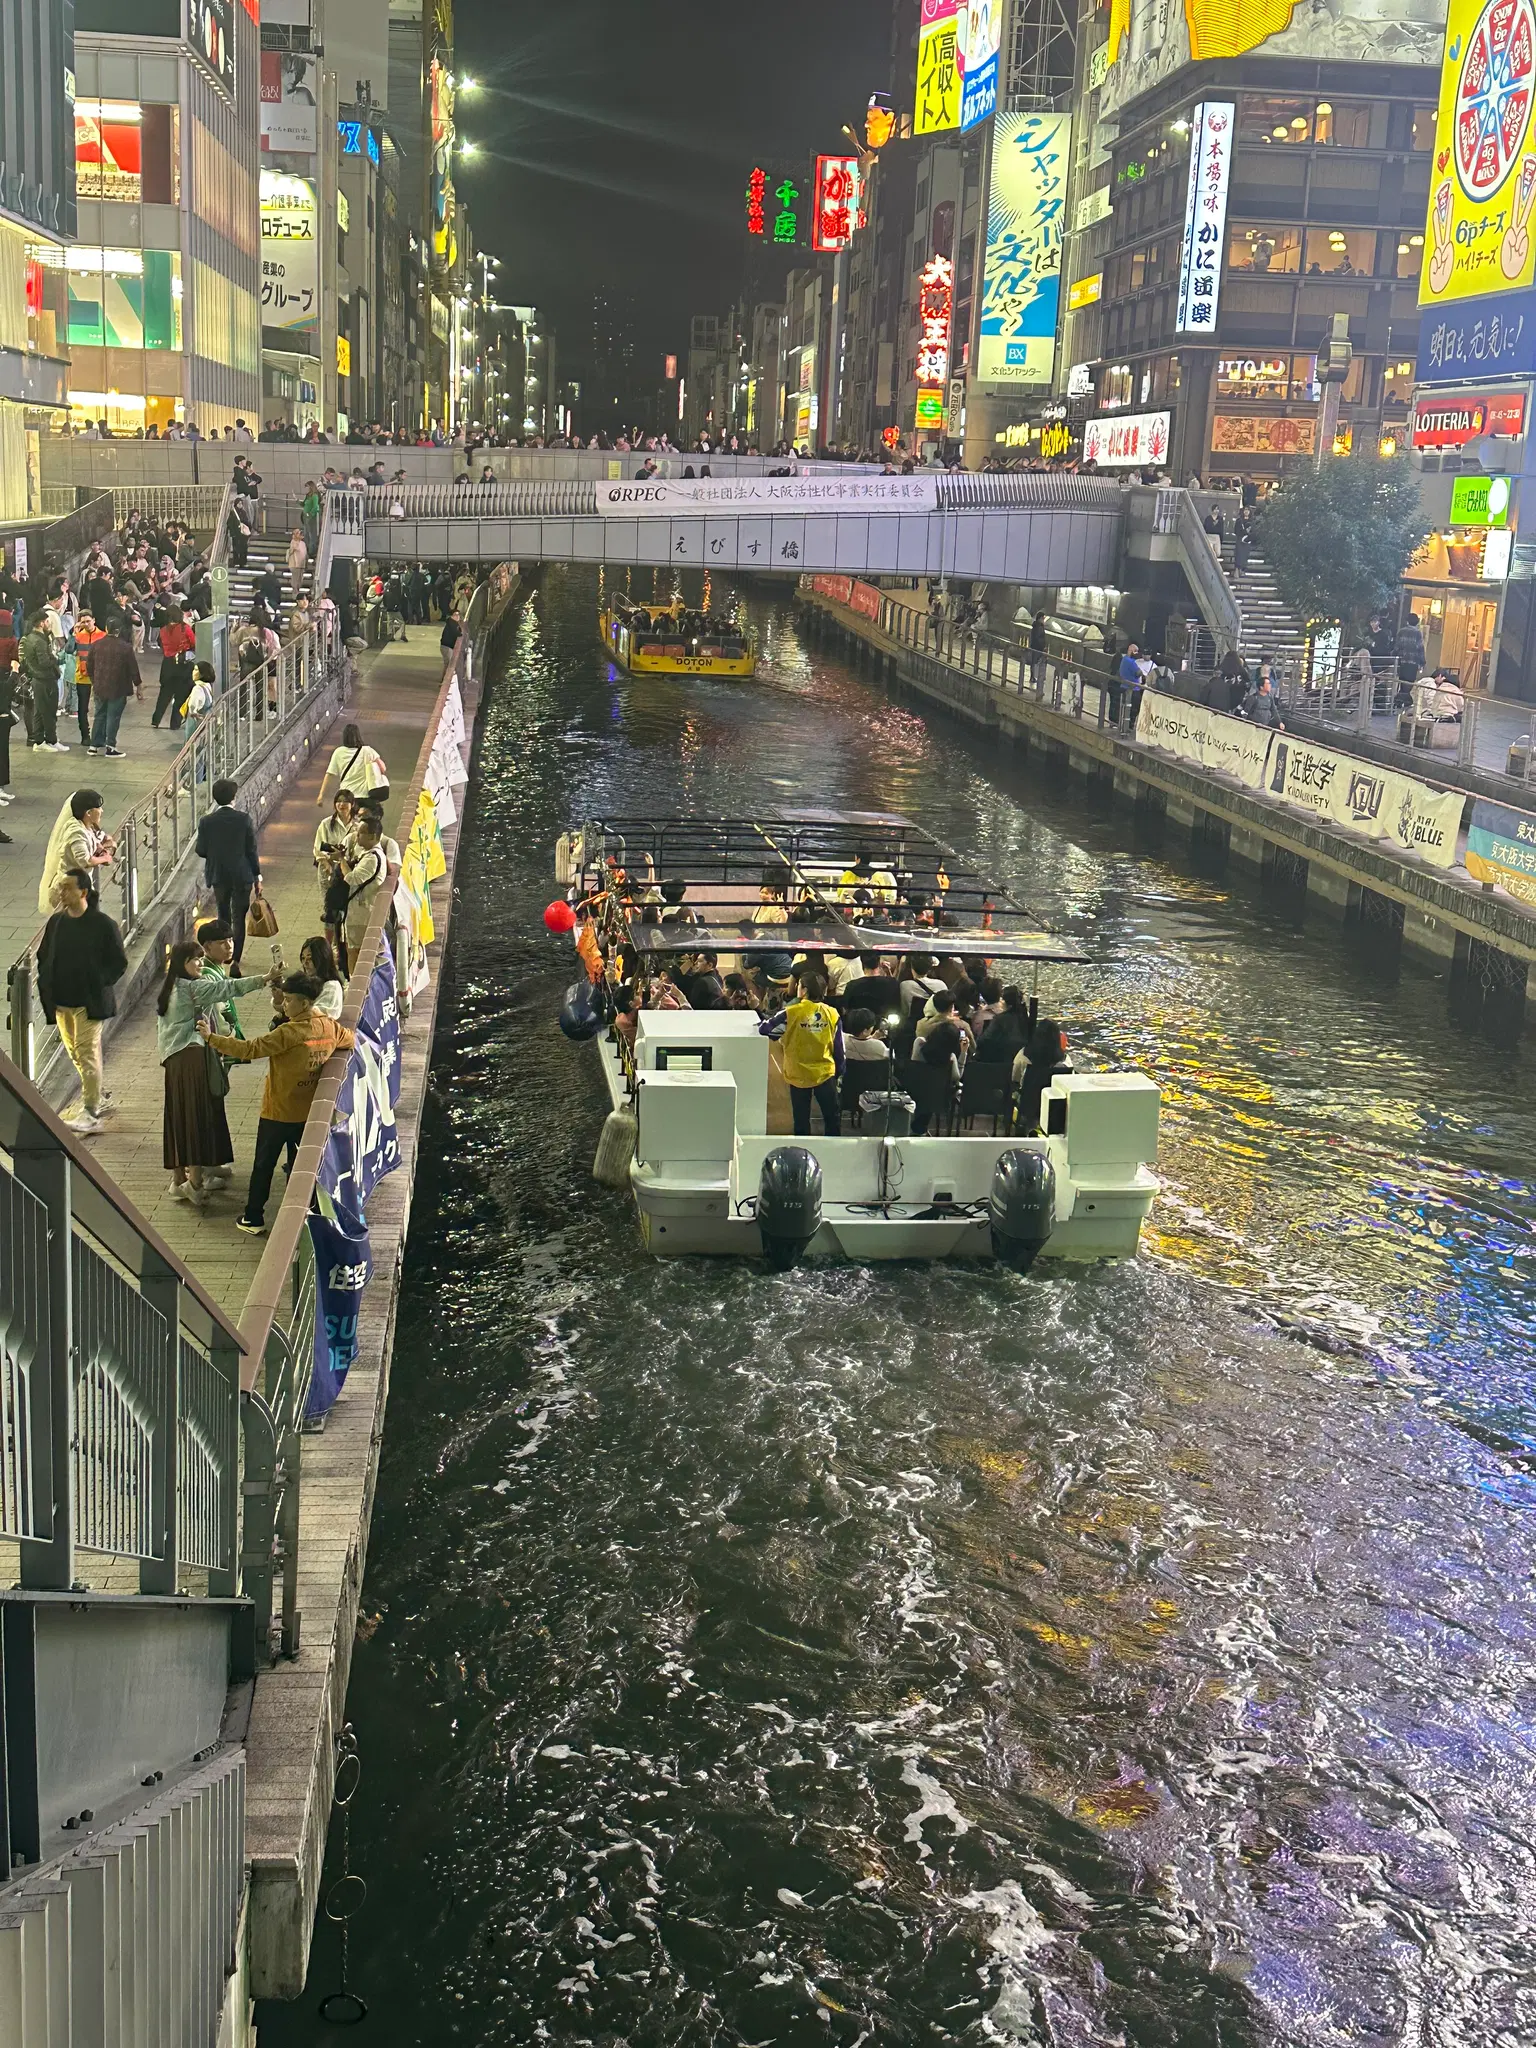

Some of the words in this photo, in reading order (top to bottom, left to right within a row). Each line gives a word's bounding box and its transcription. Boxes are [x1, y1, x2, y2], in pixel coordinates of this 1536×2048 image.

[921, 34, 940, 129] バイト
[938, 31, 956, 125] 高収入
[1204, 138, 1224, 214] 本場の味
[1013, 117, 1064, 273] シャッターは
[261, 216, 312, 238] ロデュース
[1191, 221, 1219, 324] かに道楽
[261, 281, 314, 312] グループ
[1008, 349, 1025, 360] BX
[1415, 411, 1470, 433] LOTTERIA
[674, 536, 799, 560] えびす橋
[675, 657, 713, 666] DOTON
[1414, 825, 1444, 846] BLUE
[1491, 841, 1536, 872] 東大阪大学
